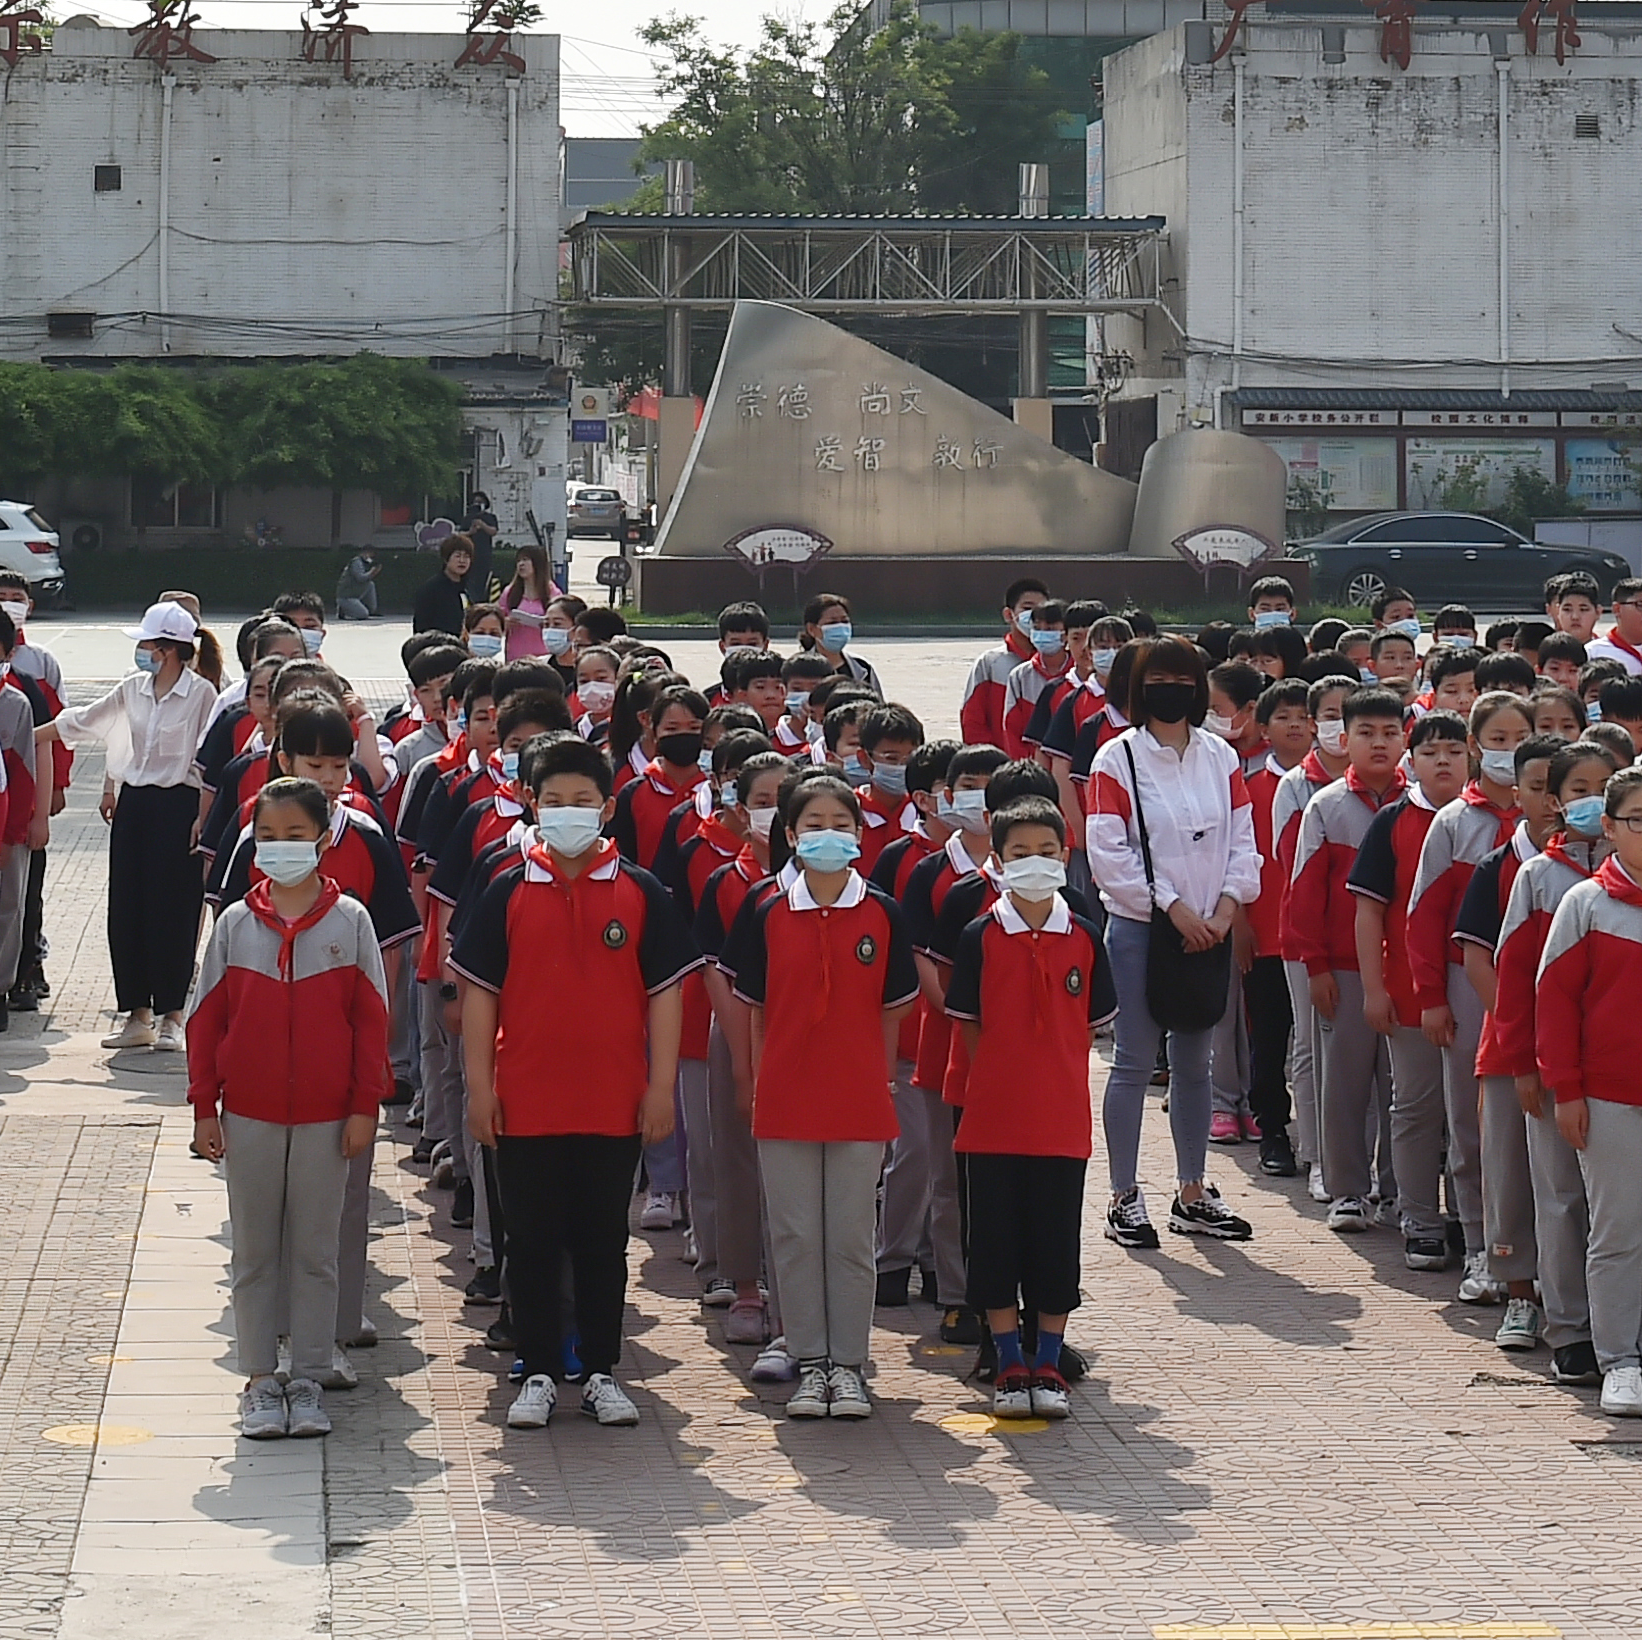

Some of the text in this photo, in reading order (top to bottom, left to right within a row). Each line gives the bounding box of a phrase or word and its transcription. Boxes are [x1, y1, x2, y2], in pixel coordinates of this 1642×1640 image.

[736, 381, 928, 420] 崇德 尚文
[1254, 412, 1380, 423] 安新小学校务公开栏
[814, 433, 1005, 473] 爱智 敦行
